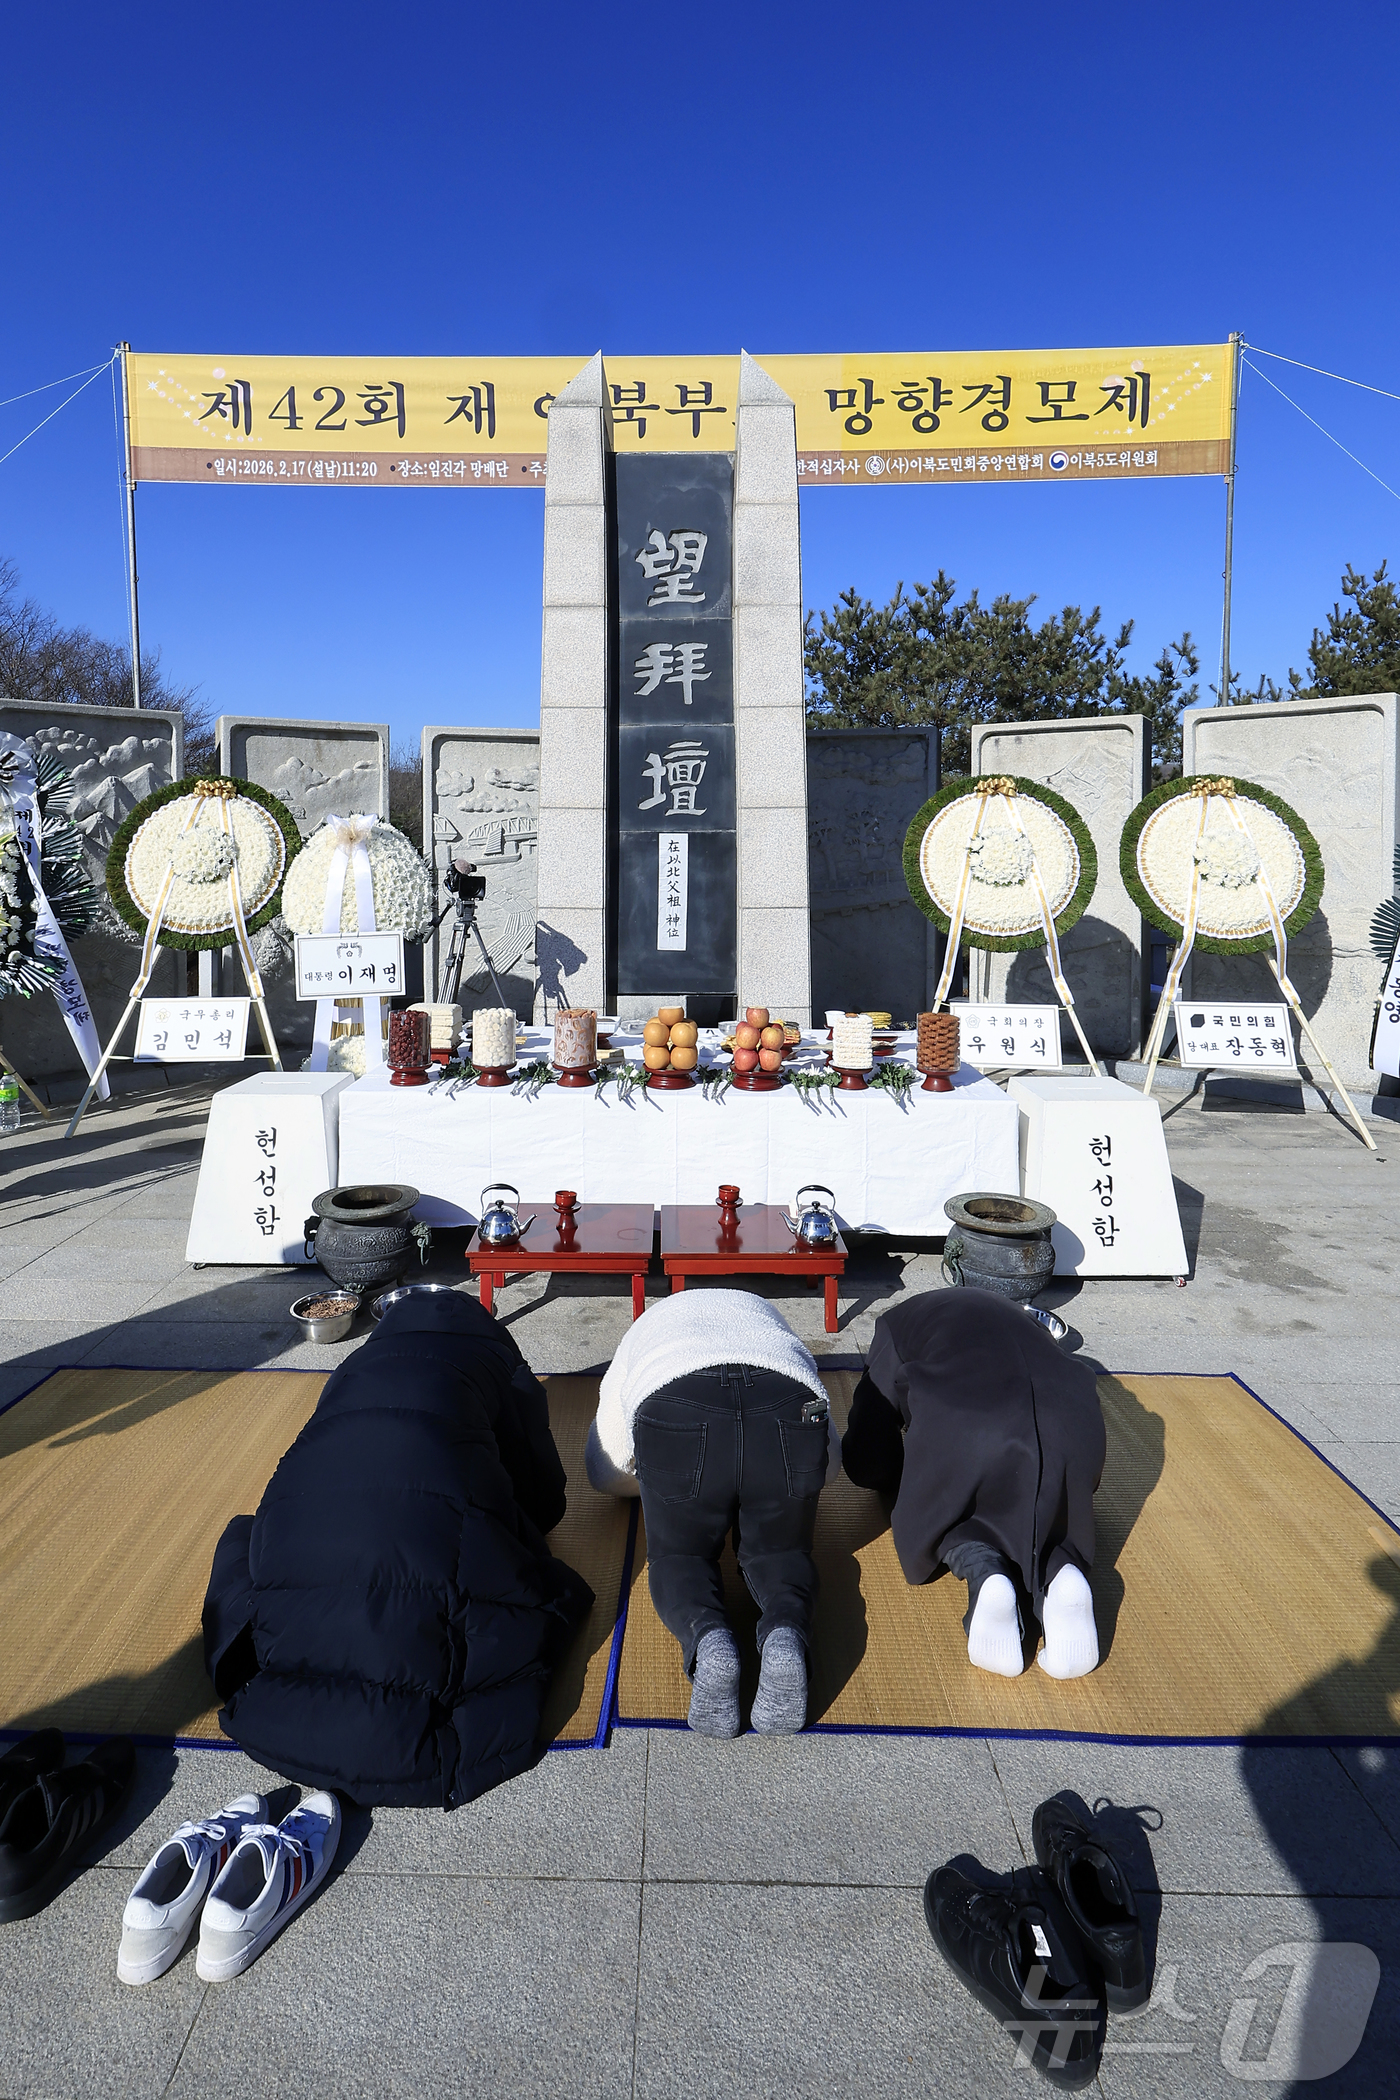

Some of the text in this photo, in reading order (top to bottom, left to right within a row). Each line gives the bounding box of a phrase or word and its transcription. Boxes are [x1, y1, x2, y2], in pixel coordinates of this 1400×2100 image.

[198, 379, 406, 438] 제42회
[443, 381, 496, 439] 재
[397, 459, 466, 478] 장소:임진각
[470, 461, 509, 478] 망배단
[529, 461, 548, 479] 주
[885, 453, 1044, 475] (사)이북도민회중앙연합회
[1070, 450, 1158, 470] 이북5도위원회
[304, 962, 396, 985] 대통령 이재명
[179, 1009, 235, 1021] 국무총리
[987, 1016, 1044, 1029] 국회의장
[1213, 1015, 1275, 1028] 국민의힘
[153, 1029, 232, 1051] 김민석
[967, 1036, 1046, 1057] 우원식
[1226, 1036, 1286, 1057] 장동혁
[253, 1126, 281, 1236] 헌성함
[1089, 1134, 1121, 1247] 헌성함
